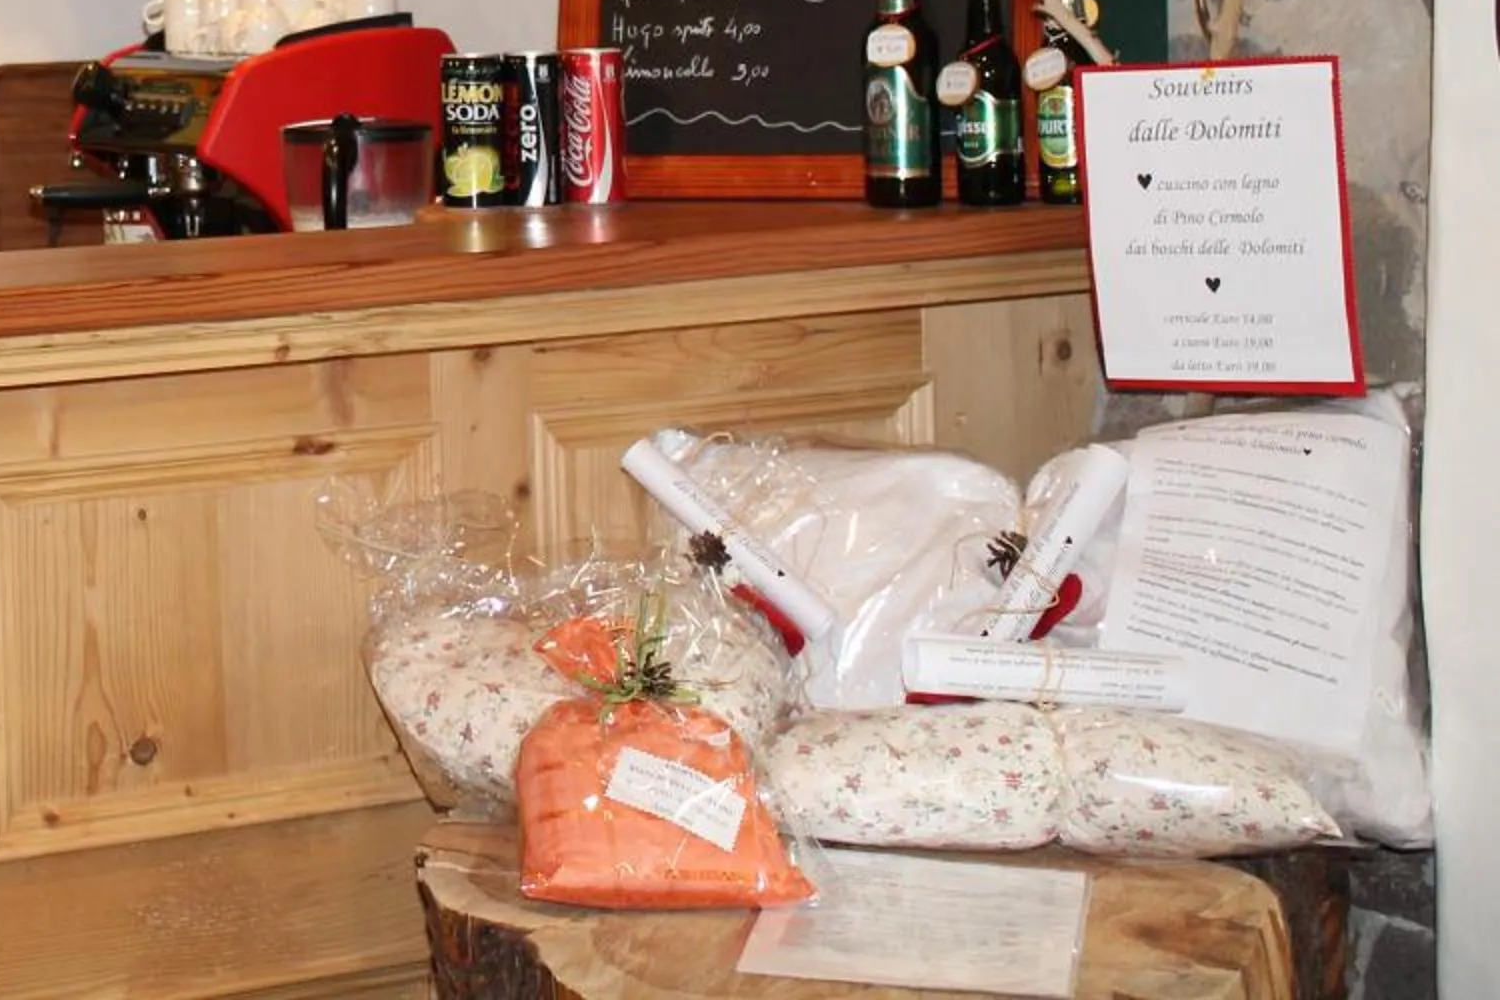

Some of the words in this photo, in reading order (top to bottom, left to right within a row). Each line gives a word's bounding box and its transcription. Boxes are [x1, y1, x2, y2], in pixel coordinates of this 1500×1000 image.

[612, 12, 664, 49] Hugo
[724, 16, 761, 43] 4,00
[730, 62, 770, 86] 3,00
[1148, 73, 1254, 100] Souvenirs
[446, 104, 500, 121] SODA
[520, 104, 537, 162] zero
[1128, 117, 1180, 143] dalle
[1185, 114, 1284, 142] Dolomiti
[1212, 178, 1238, 192] con
[1240, 173, 1280, 195] legno
[1197, 238, 1231, 256] delle
[1237, 237, 1306, 256] Dolomiti
